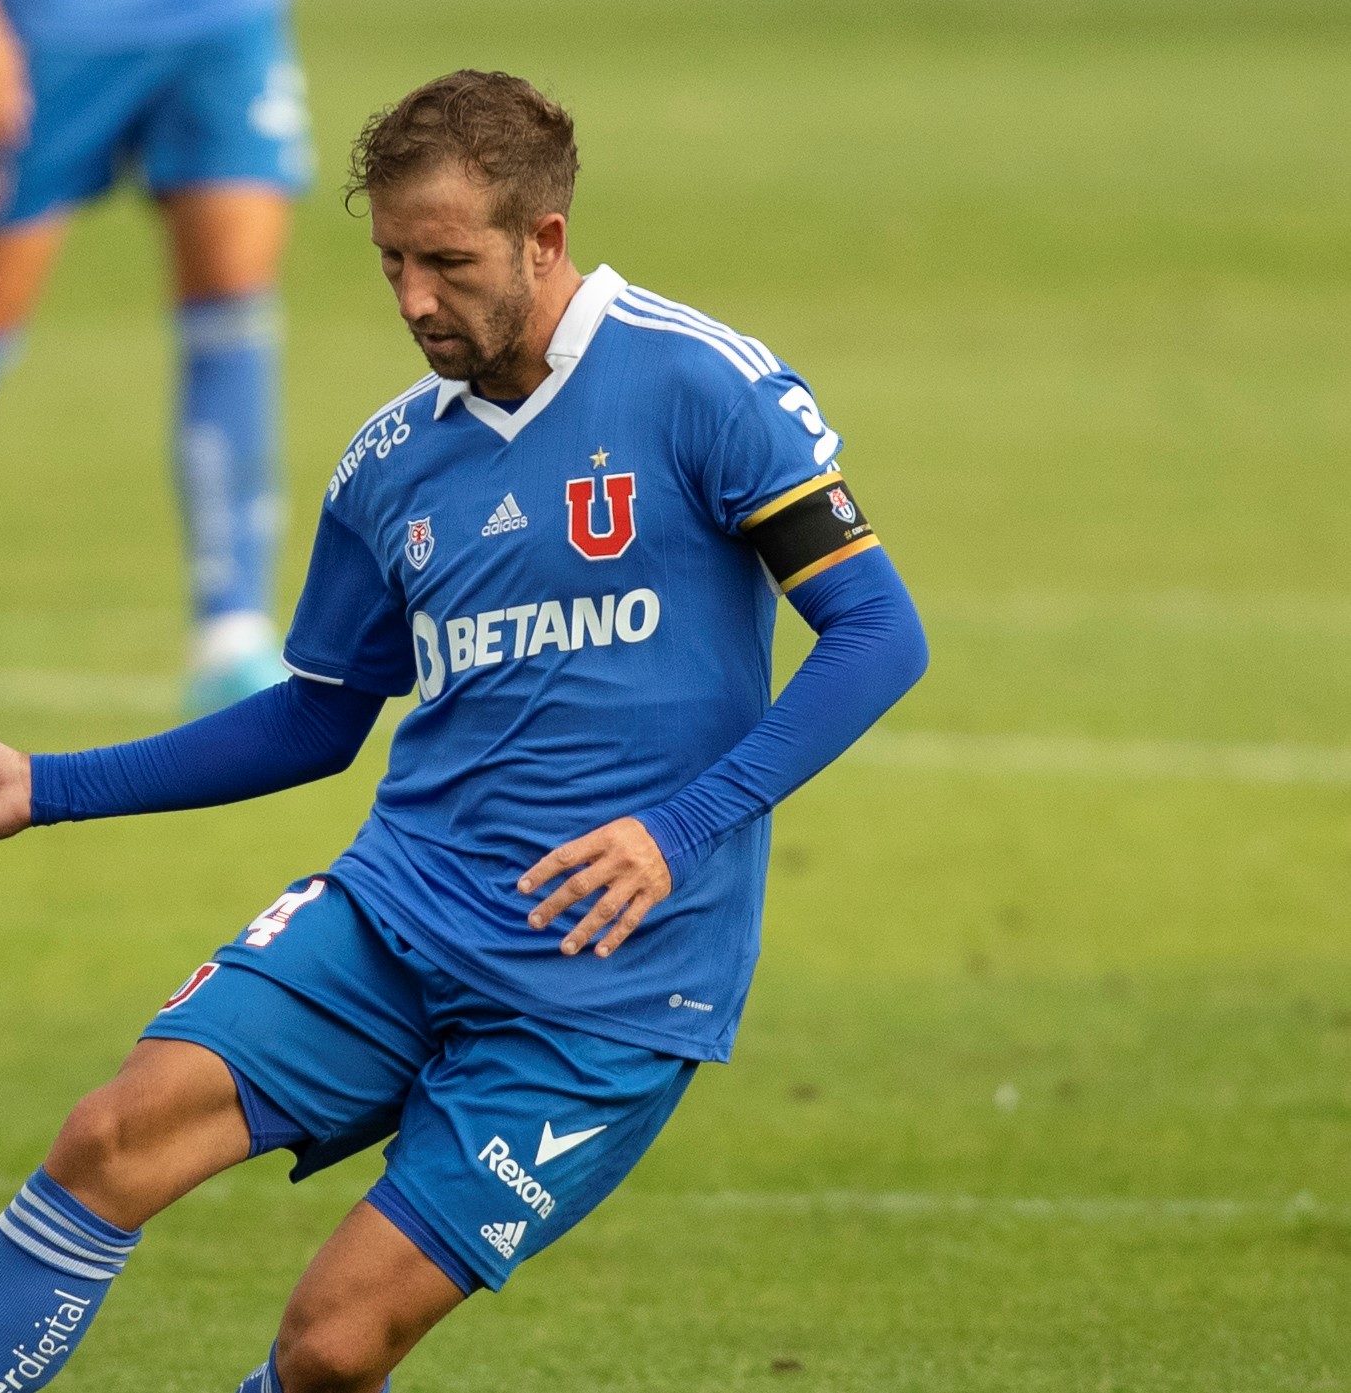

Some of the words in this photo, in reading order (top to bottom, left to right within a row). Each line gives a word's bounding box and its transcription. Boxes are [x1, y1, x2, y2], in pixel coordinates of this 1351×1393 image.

[328, 402, 408, 502] DIRECTV
[375, 423, 411, 459] GO
[412, 542, 426, 561] U
[481, 515, 528, 537] adidas
[566, 472, 636, 561] U
[446, 587, 661, 674] BETANO
[477, 1135, 556, 1220] Rexona
